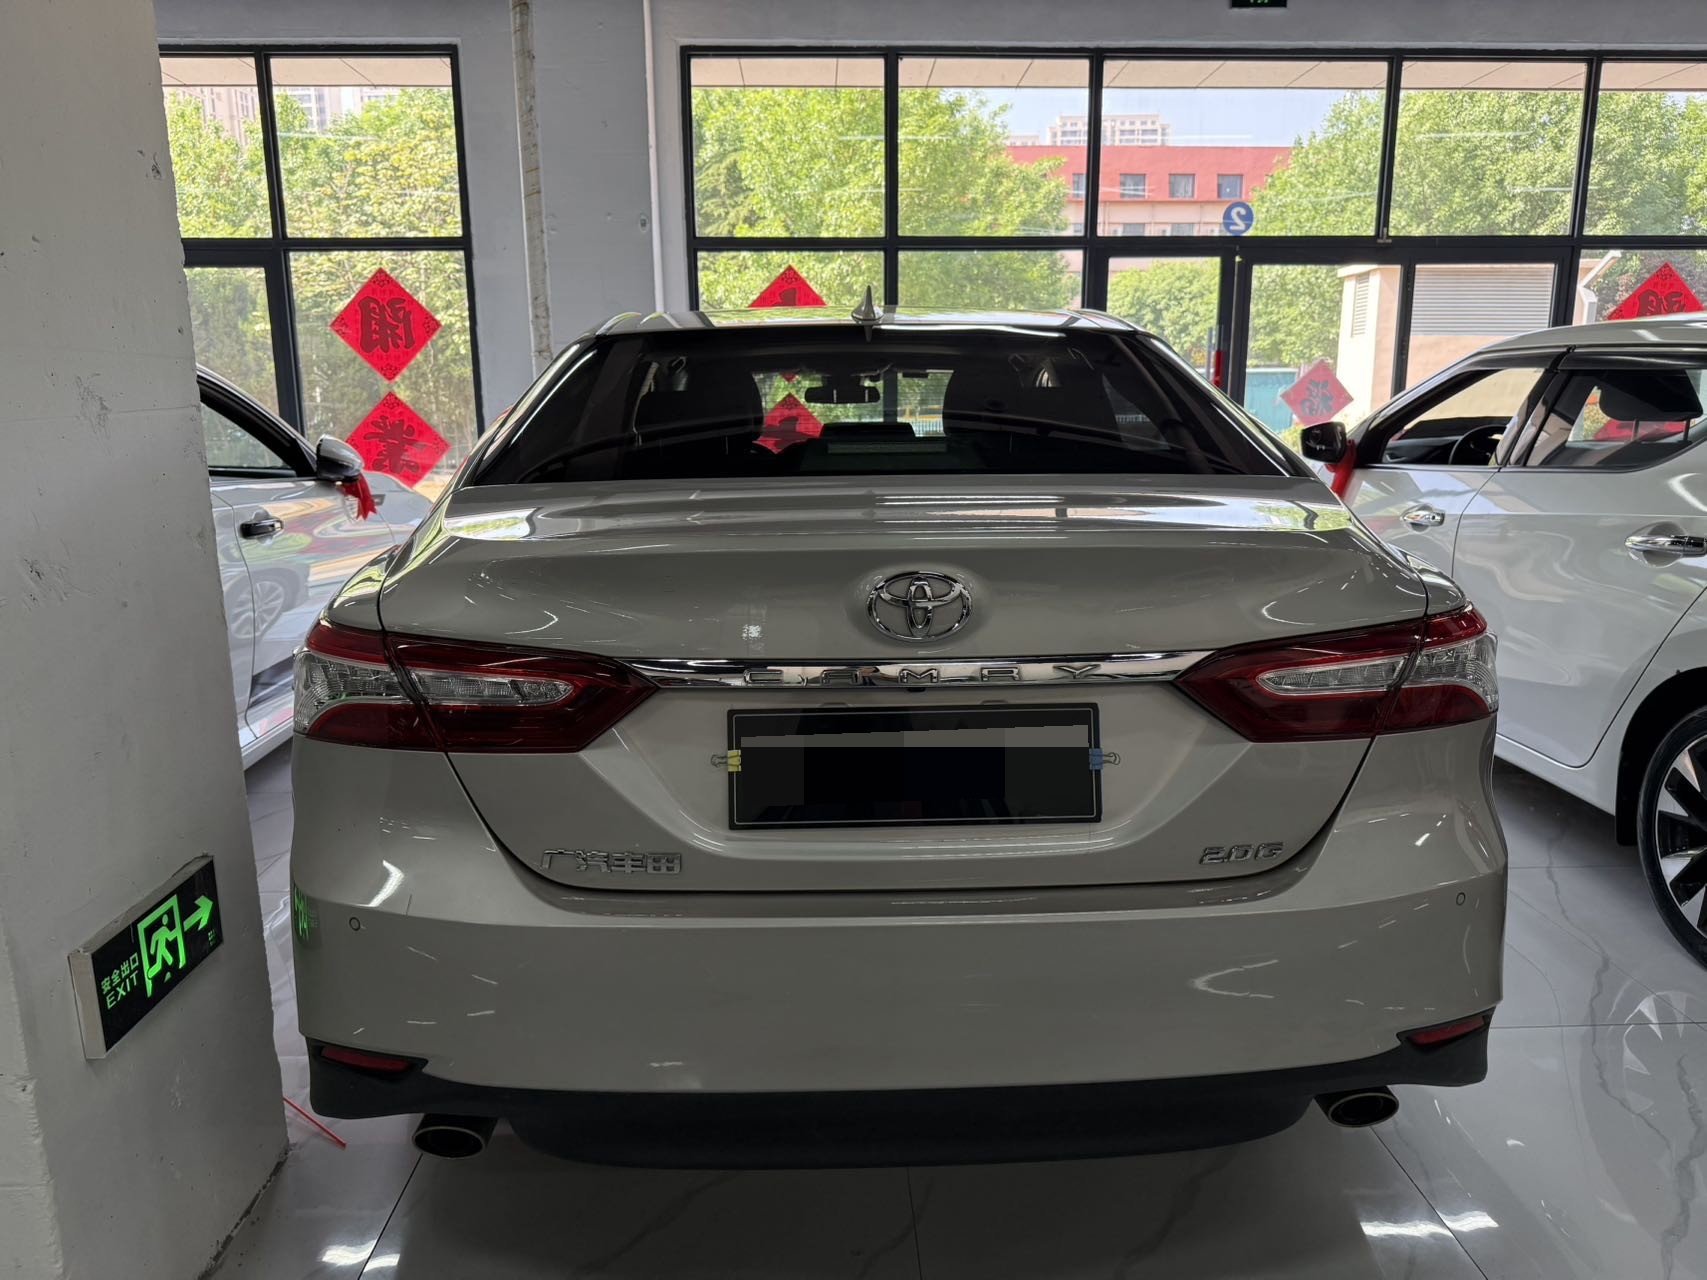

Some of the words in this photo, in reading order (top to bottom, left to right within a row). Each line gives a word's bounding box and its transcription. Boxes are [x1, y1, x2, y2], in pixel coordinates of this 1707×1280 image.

[743, 664, 1100, 684] CAMRY
[541, 849, 682, 875] 广汽丰田
[1199, 842, 1284, 865] 2.0G
[101, 952, 139, 994] 安全出口
[106, 970, 139, 1010] EXIT
